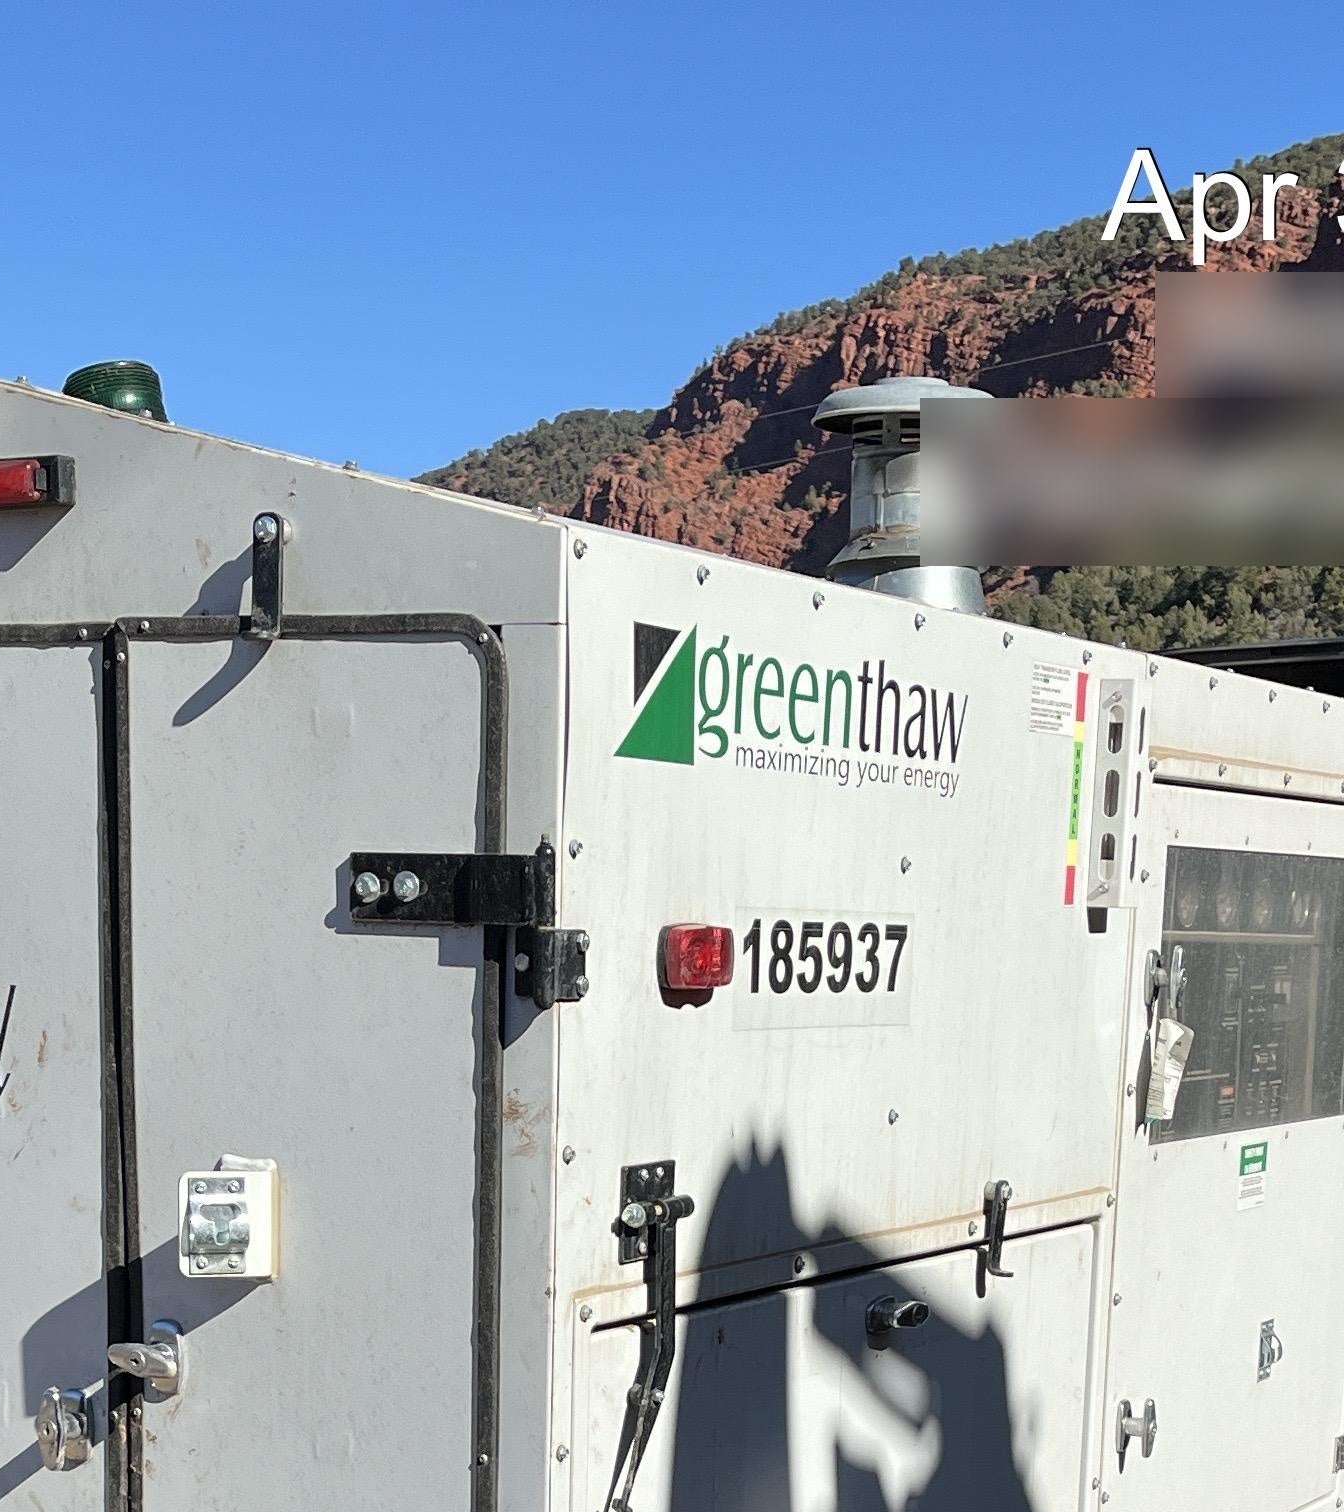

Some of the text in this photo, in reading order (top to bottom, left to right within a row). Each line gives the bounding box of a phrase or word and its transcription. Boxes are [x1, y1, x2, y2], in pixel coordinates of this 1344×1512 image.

[698, 635, 968, 763] greenthaw
[736, 742, 959, 797] maximizing your energy
[742, 919, 908, 993] 185937
